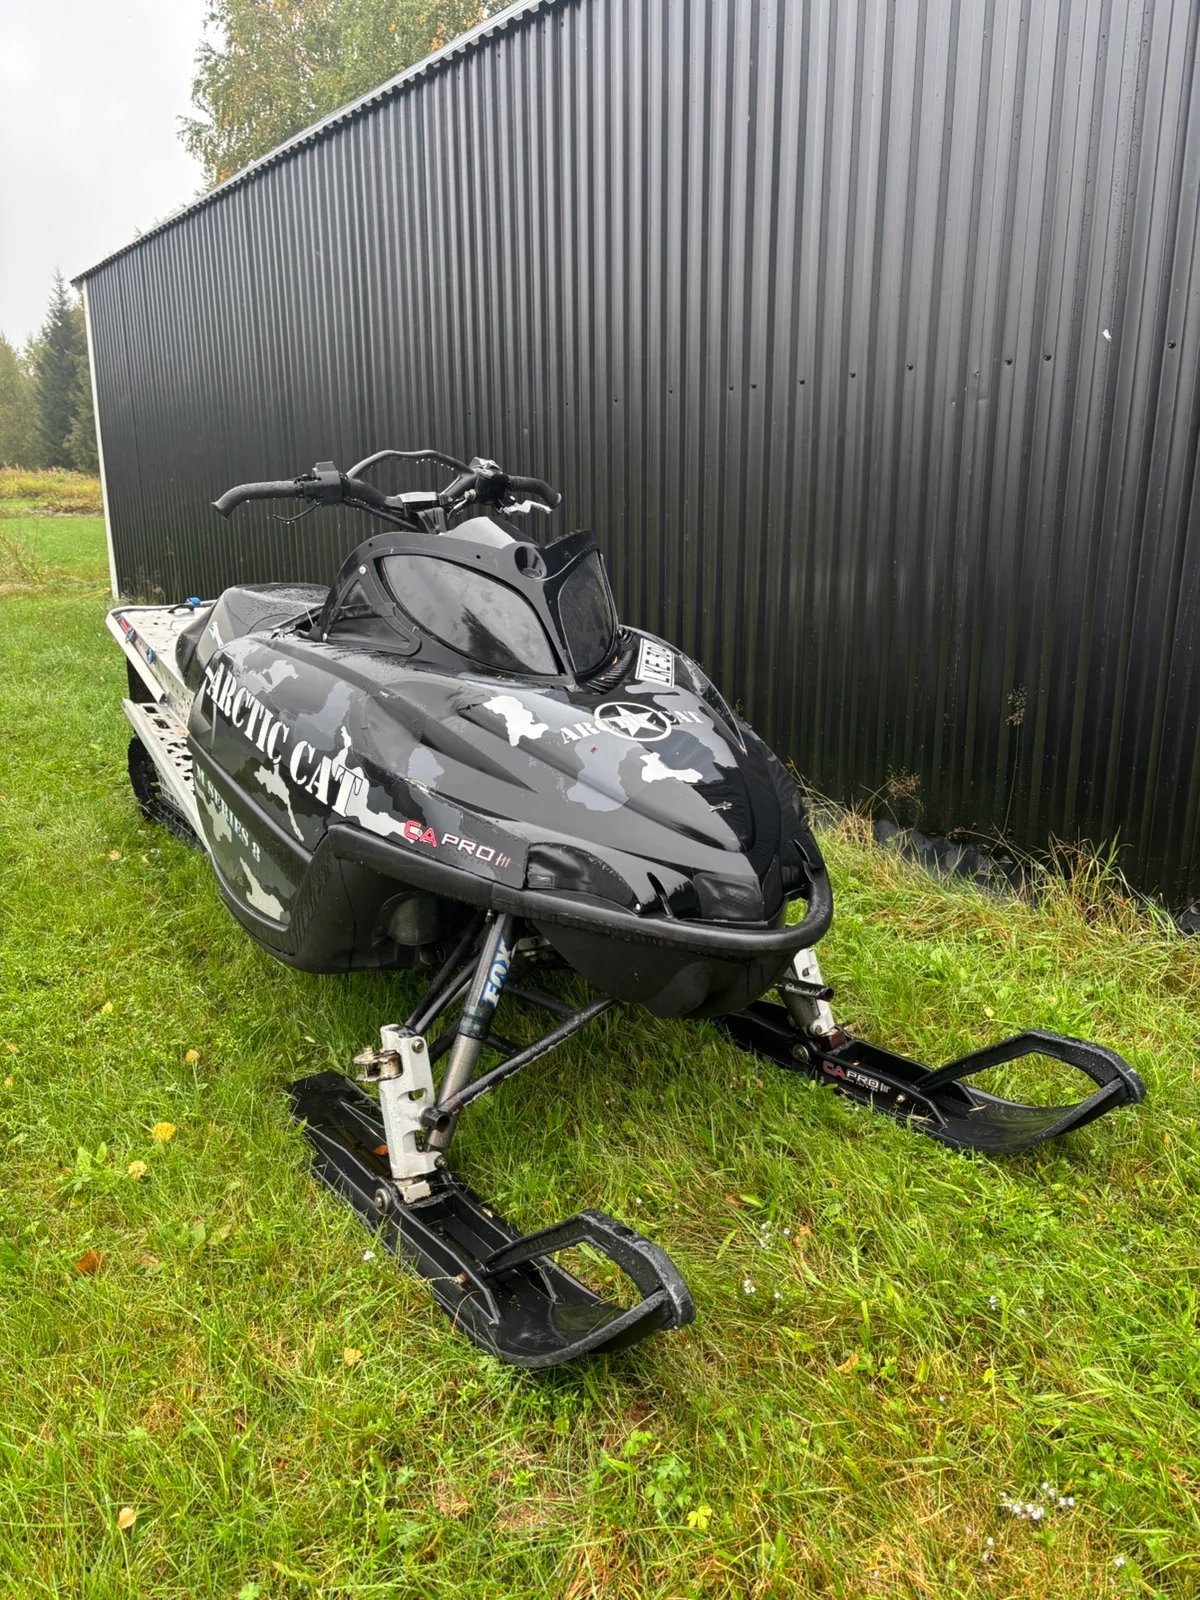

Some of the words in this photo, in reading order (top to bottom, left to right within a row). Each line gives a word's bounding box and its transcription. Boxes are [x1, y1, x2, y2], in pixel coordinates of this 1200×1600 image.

[205, 662, 290, 764] ARCTIC
[290, 740, 363, 817] CAT
[196, 763, 205, 786] M
[207, 780, 249, 847] SERIES
[441, 833, 495, 862] PRO
[484, 935, 511, 1008] FOX
[846, 1070, 879, 1089] PRO
